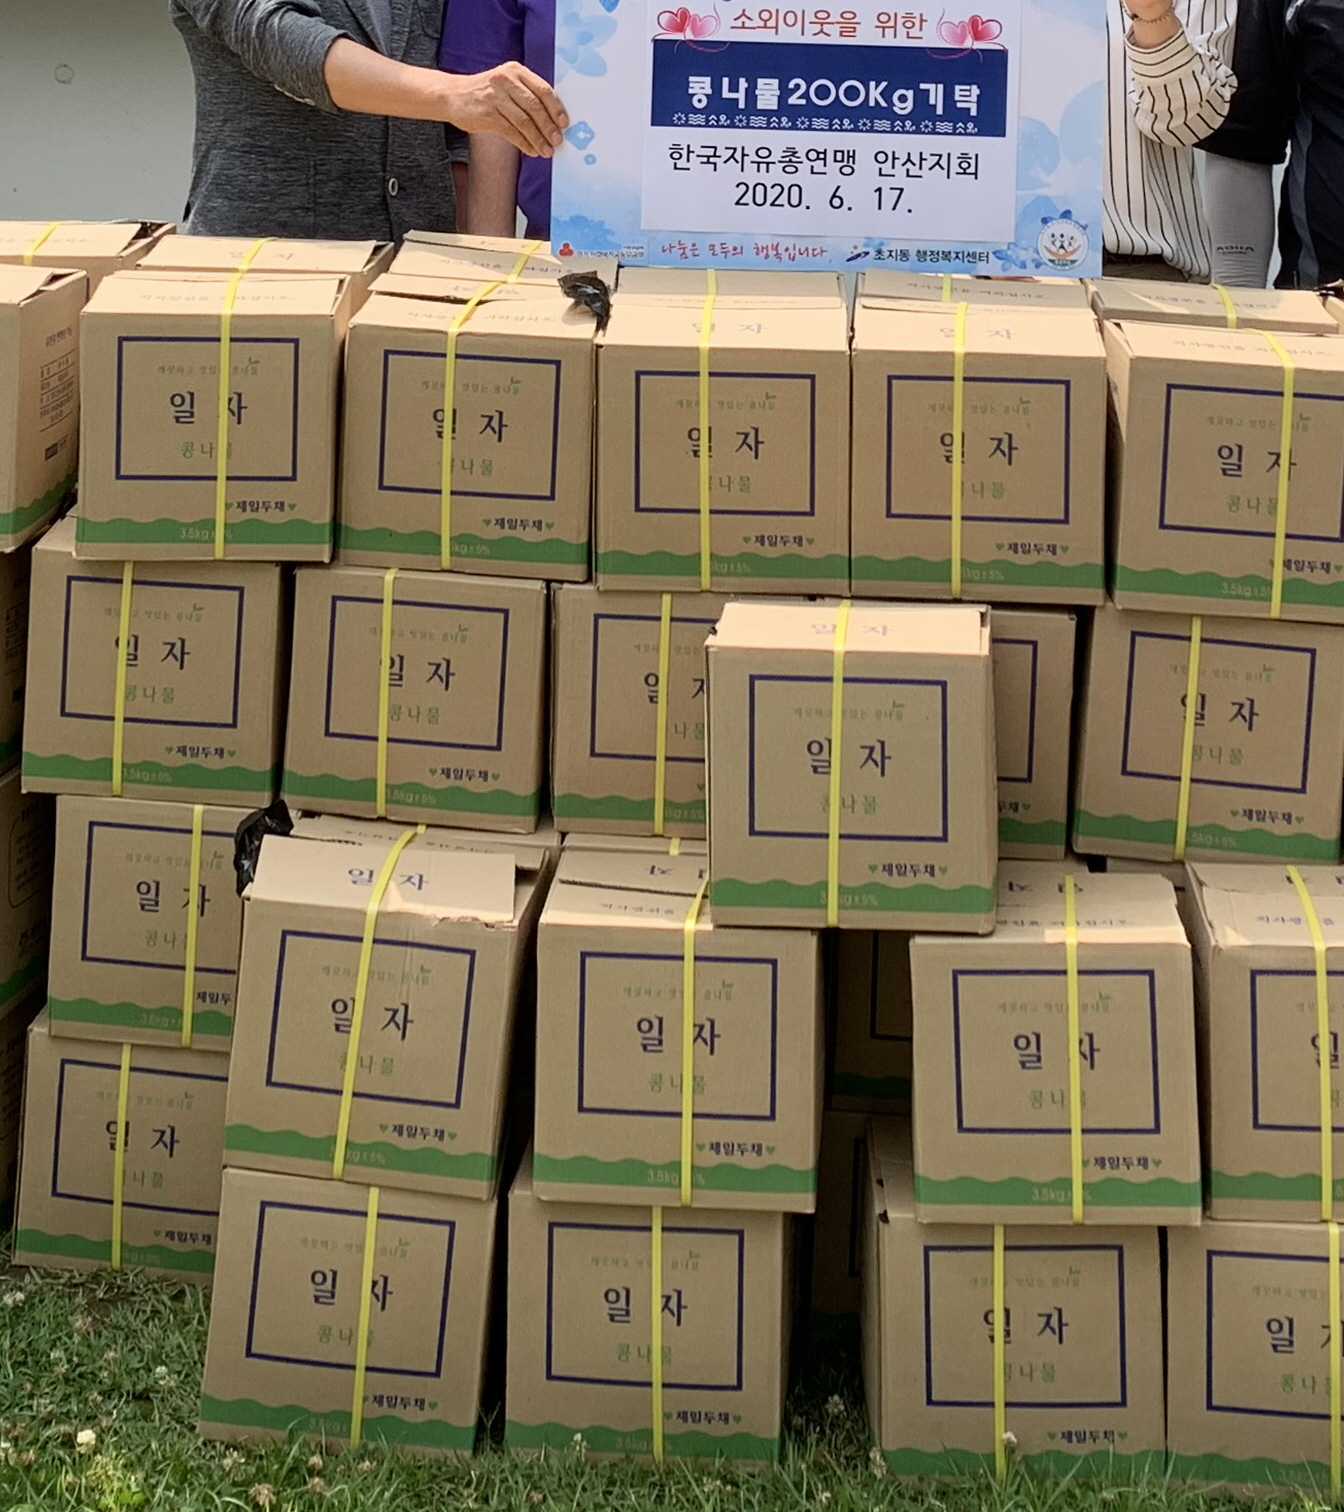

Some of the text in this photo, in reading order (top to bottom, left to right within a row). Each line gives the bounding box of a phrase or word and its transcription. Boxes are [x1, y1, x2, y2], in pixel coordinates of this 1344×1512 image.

[730, 8, 927, 39] 소외이웃을 위한
[668, 143, 980, 180] 한국자유총연맹 안산지회
[734, 182, 913, 213] 2020. 6. 17.
[662, 240, 700, 259] 나눔은
[708, 242, 744, 259] 모두의
[874, 249, 989, 264] 초지동 행정복지센터
